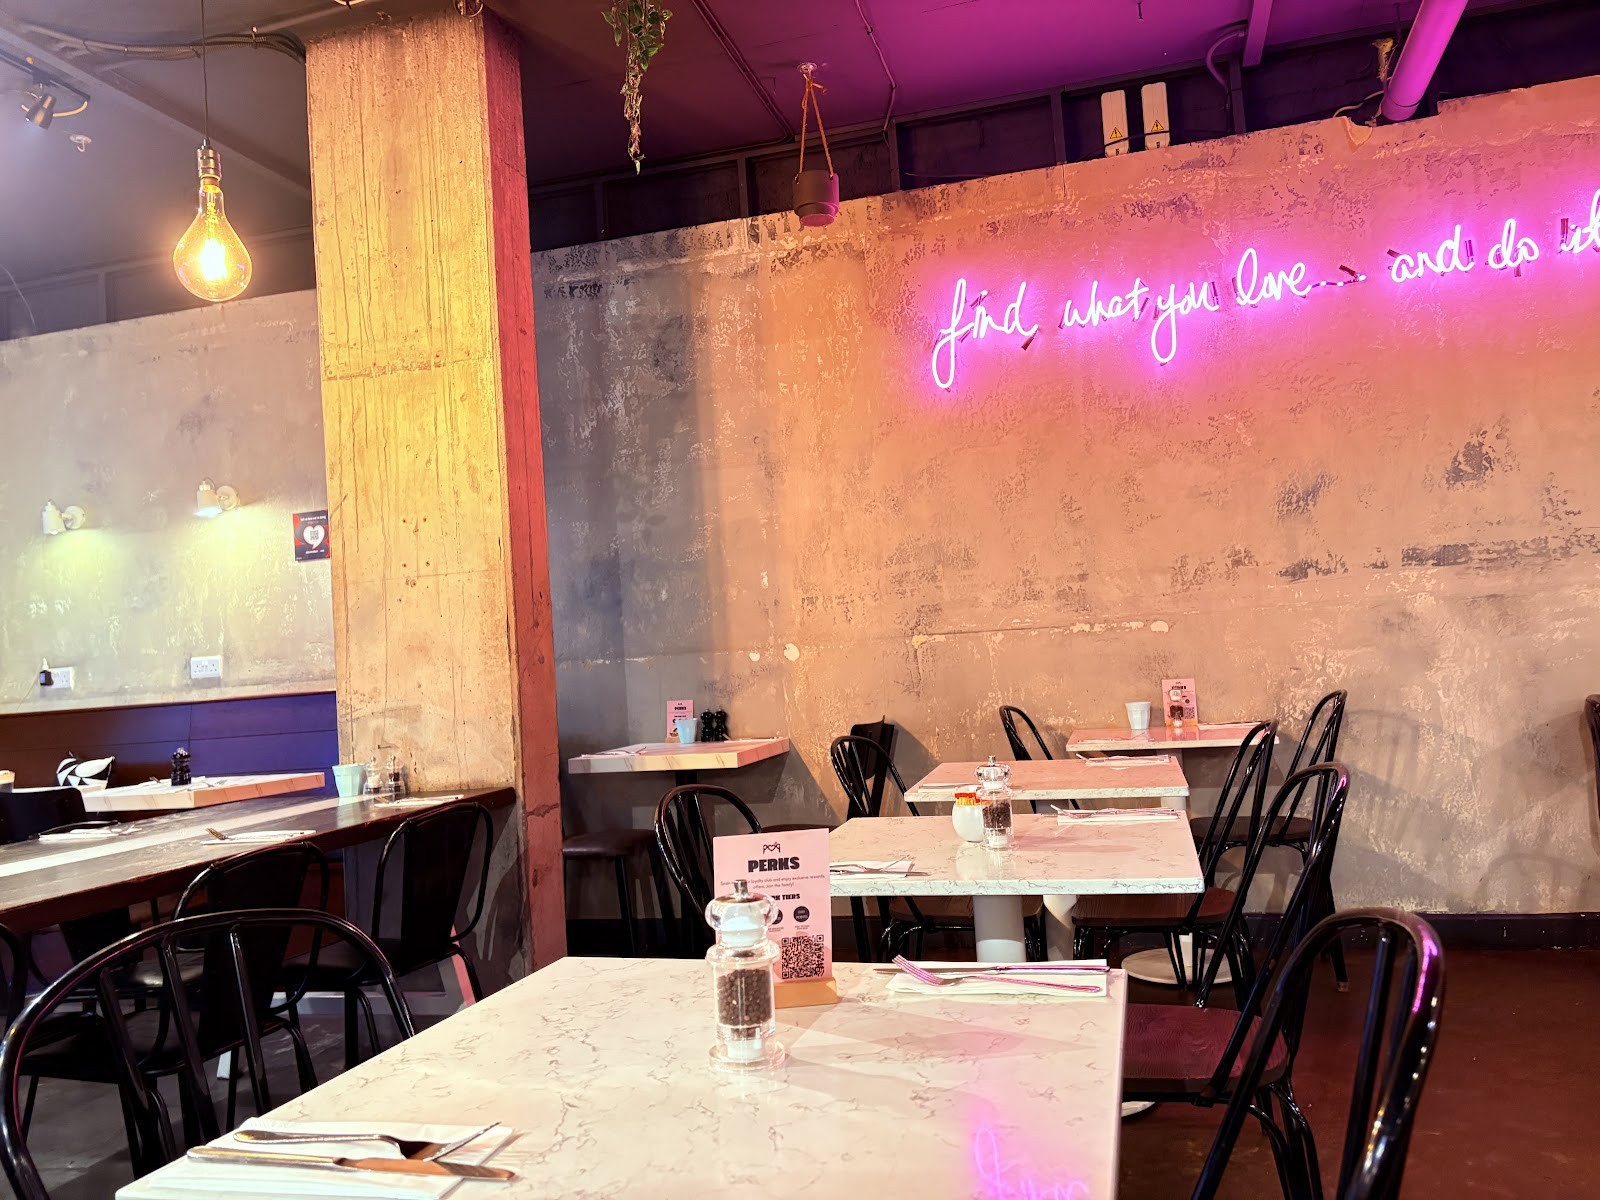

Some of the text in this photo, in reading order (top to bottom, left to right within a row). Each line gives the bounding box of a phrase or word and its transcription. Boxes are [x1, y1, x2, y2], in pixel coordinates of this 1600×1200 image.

[931, 278, 1039, 388] find
[1063, 277, 1149, 327] what
[1150, 281, 1220, 363] you
[1391, 224, 1474, 283] and
[1488, 218, 1540, 270] do
[748, 856, 800, 873] PERKS
